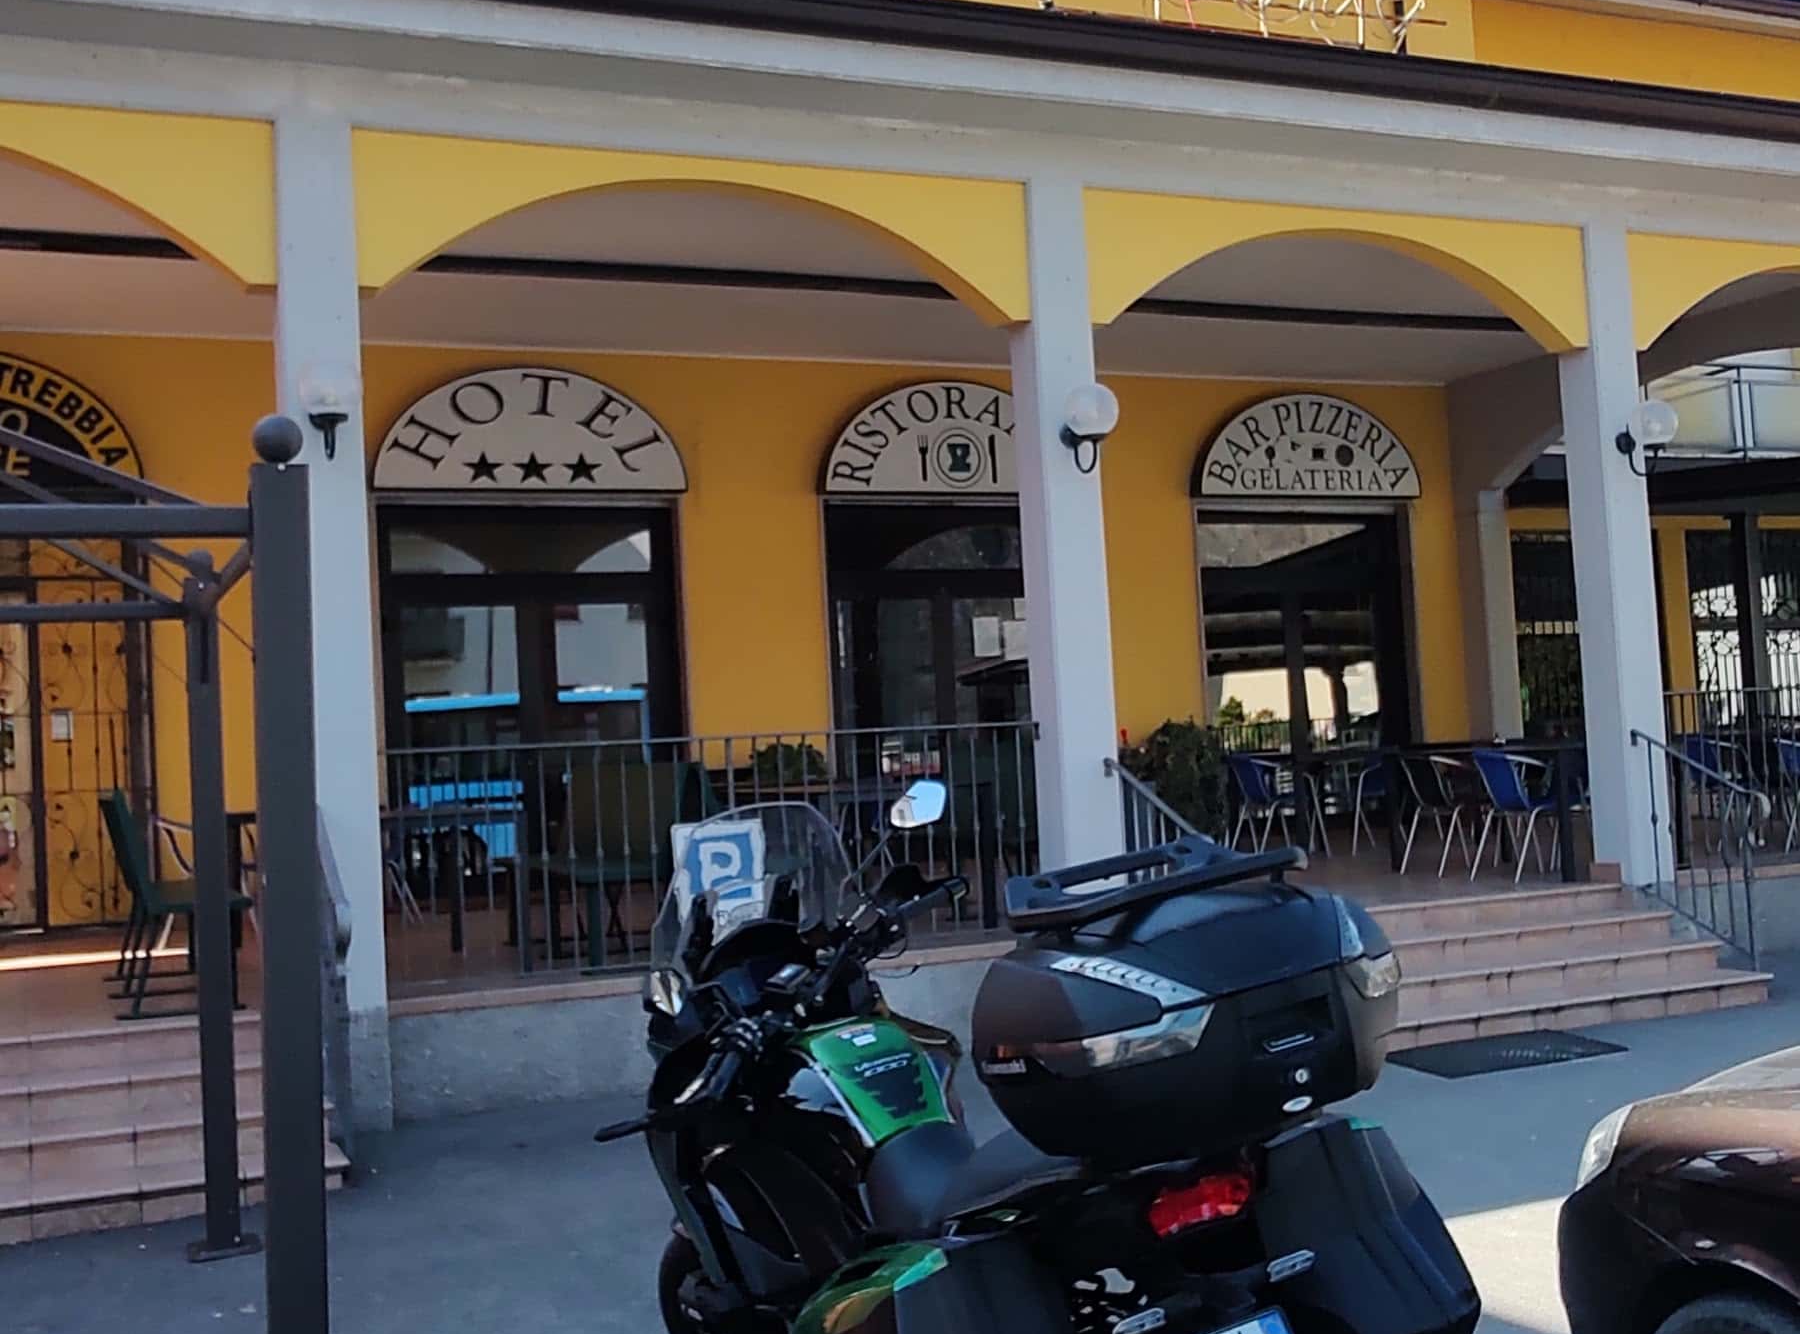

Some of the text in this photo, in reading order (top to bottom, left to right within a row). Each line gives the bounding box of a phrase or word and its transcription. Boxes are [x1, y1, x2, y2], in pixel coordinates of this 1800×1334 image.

[387, 372, 665, 473] HOTEL
[831, 386, 1015, 487] RISTORA
[1208, 401, 1410, 490] BAR PIZZERIA
[1241, 468, 1382, 491] GELATERIA
